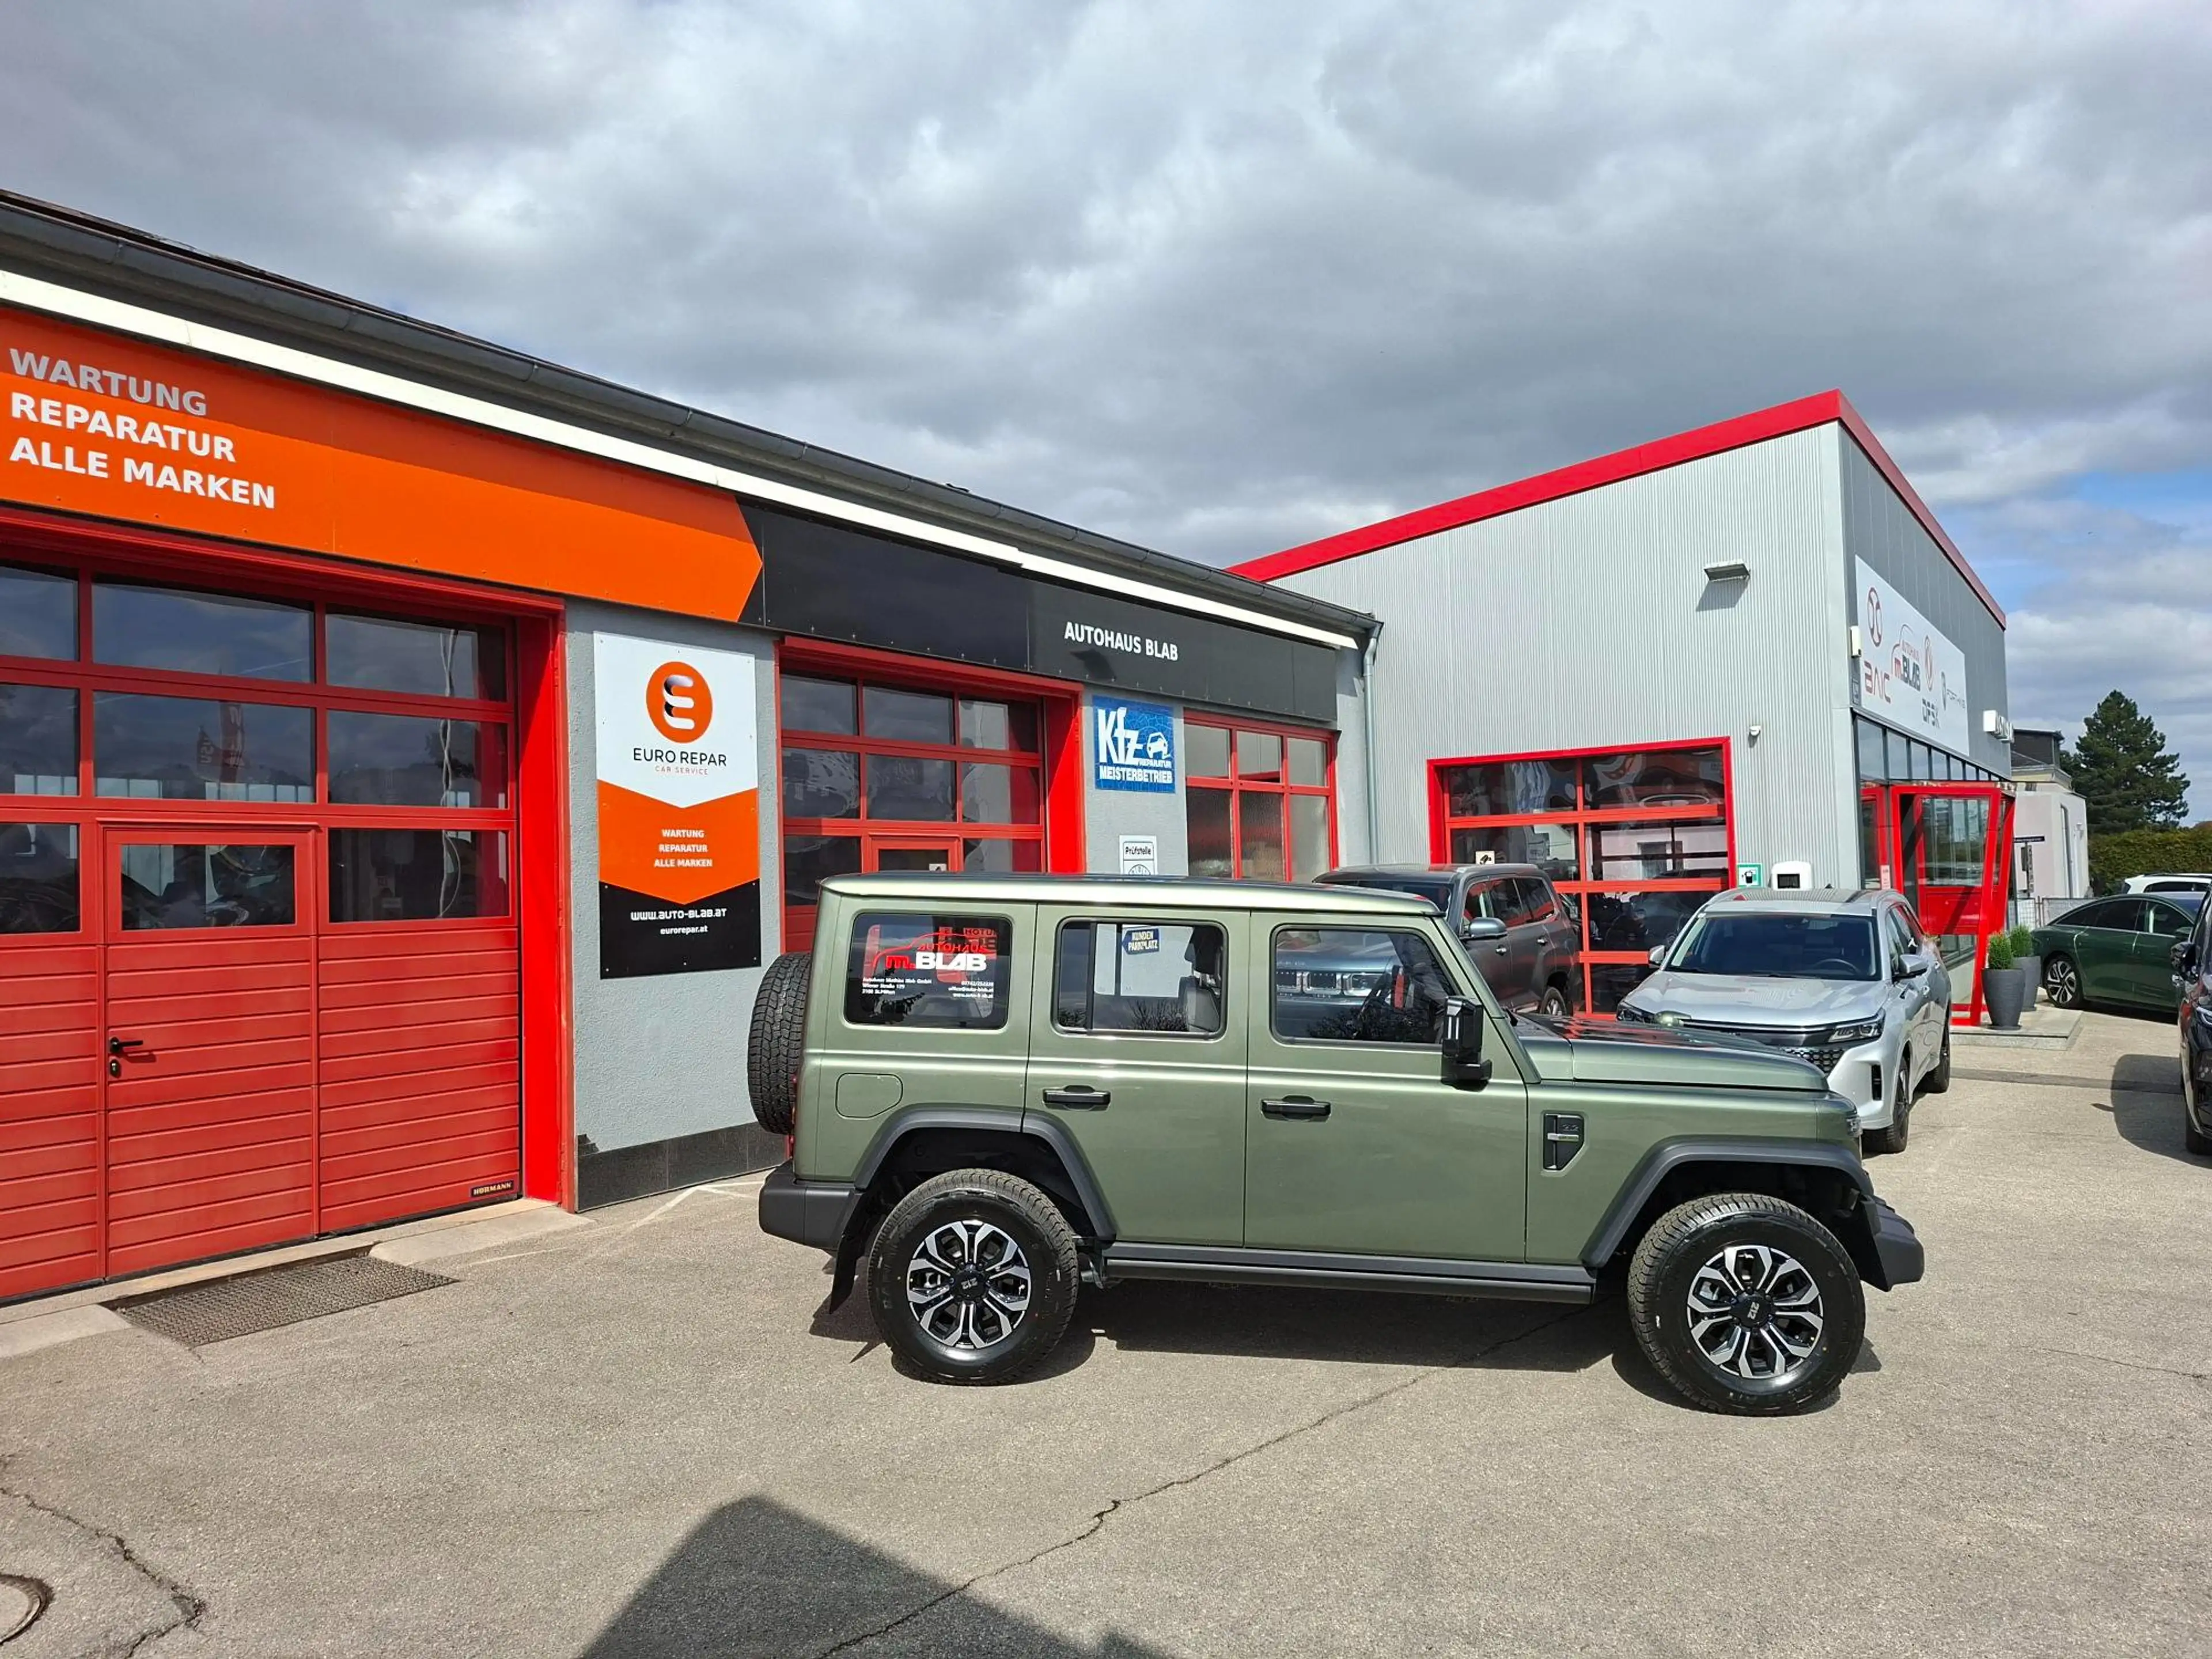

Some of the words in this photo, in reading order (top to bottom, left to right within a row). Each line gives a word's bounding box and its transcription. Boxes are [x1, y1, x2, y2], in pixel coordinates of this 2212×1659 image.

[10, 349, 207, 416] WARTUNG
[10, 392, 236, 462] REPARATUR
[9, 437, 109, 478] ALLE
[123, 457, 275, 509] MARKEN
[1065, 621, 1142, 654] AUTOHAUS
[1145, 638, 1178, 661] BLAB
[633, 747, 677, 763] EURO
[680, 751, 727, 767] REPAR
[675, 767, 709, 775] SERVICE
[1099, 765, 1173, 784] MEISTERBETRIEB
[661, 828, 704, 838] WARTUNG
[658, 843, 707, 853] REPARATUR
[1125, 846, 1152, 855] Prüfstelle
[654, 858, 675, 868] ALLE
[677, 858, 713, 868] MARKEN
[660, 925, 709, 935] eurorepar.at
